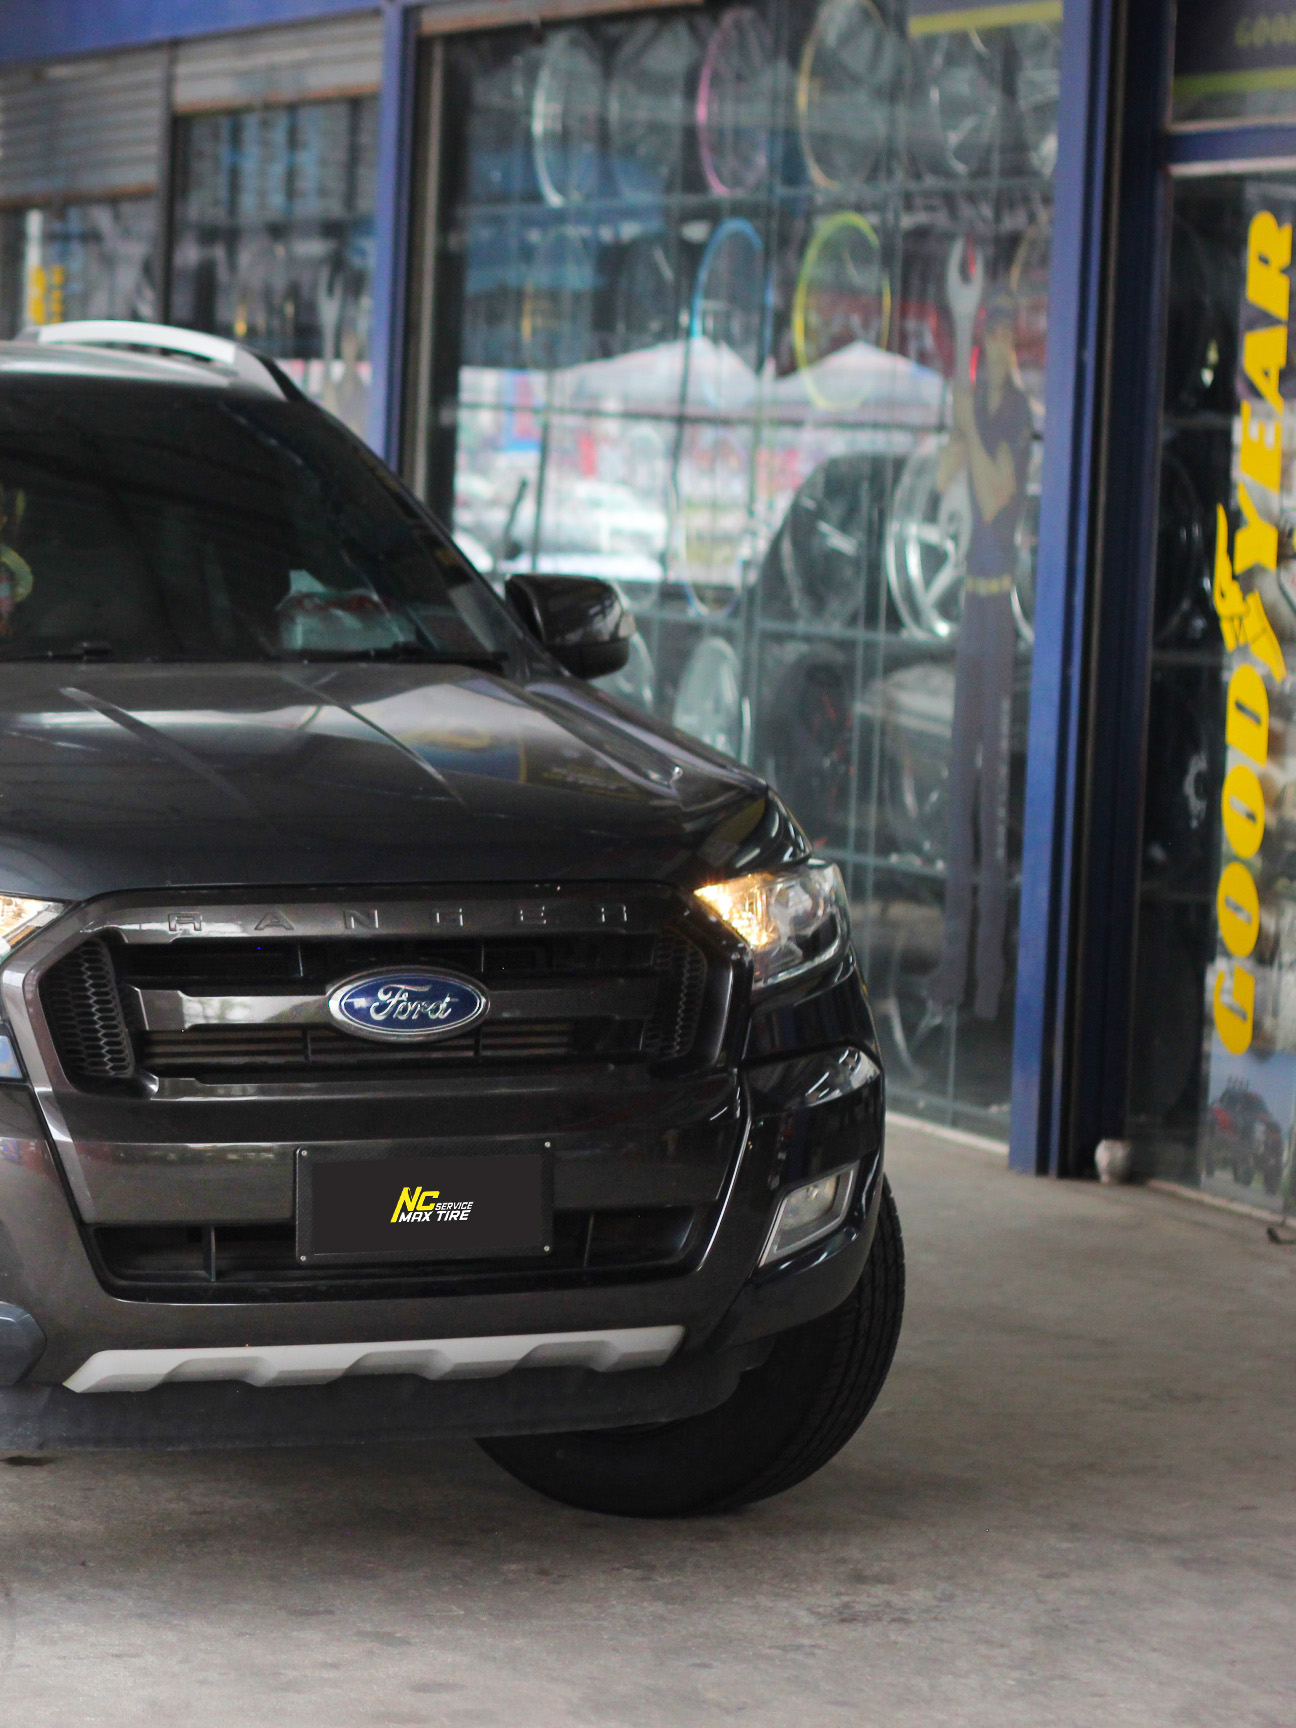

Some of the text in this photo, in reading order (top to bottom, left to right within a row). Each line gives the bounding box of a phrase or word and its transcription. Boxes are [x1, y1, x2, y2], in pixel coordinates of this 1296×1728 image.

[1214, 210, 1293, 1055] GOODYEAR
[167, 903, 628, 933] RANGER
[369, 983, 454, 1021] Ford
